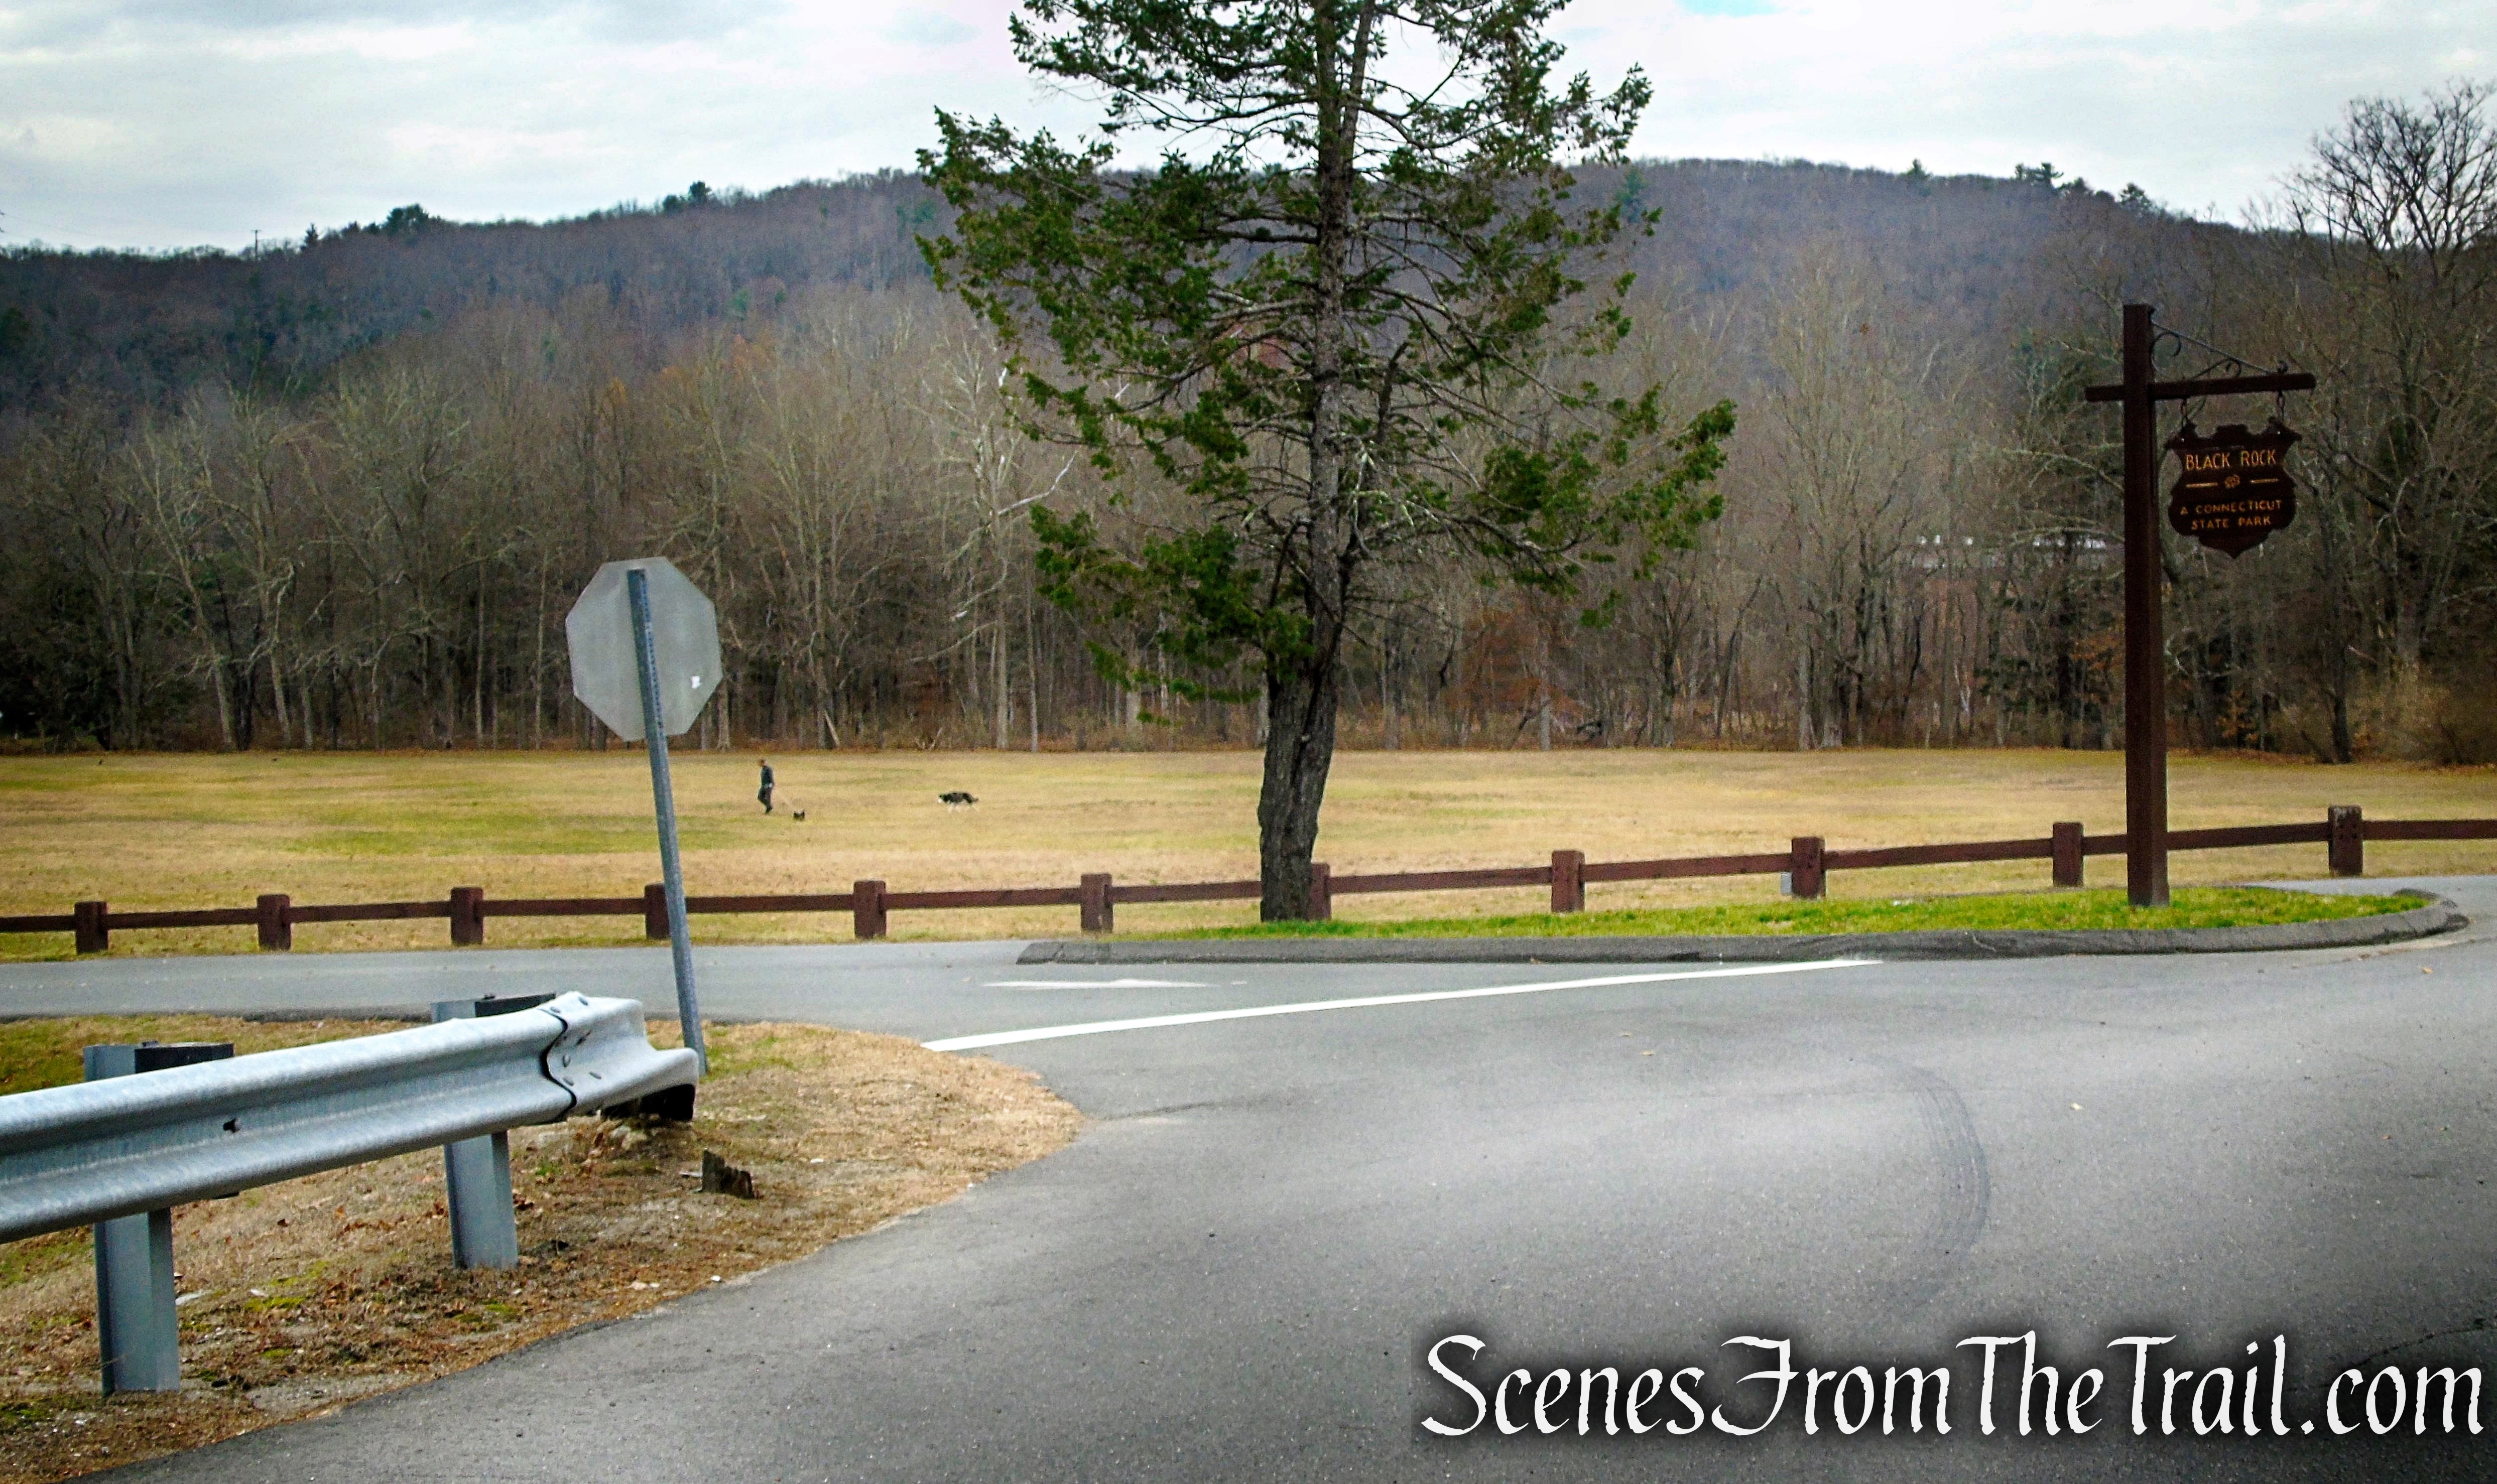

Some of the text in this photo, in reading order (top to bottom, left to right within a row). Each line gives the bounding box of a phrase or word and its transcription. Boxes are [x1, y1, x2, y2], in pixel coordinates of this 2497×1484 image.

[2186, 450, 2277, 471] BLACK ROCK
[2180, 500, 2282, 515] A CONNECTICUT
[2192, 515, 2272, 530] STATE PARK
